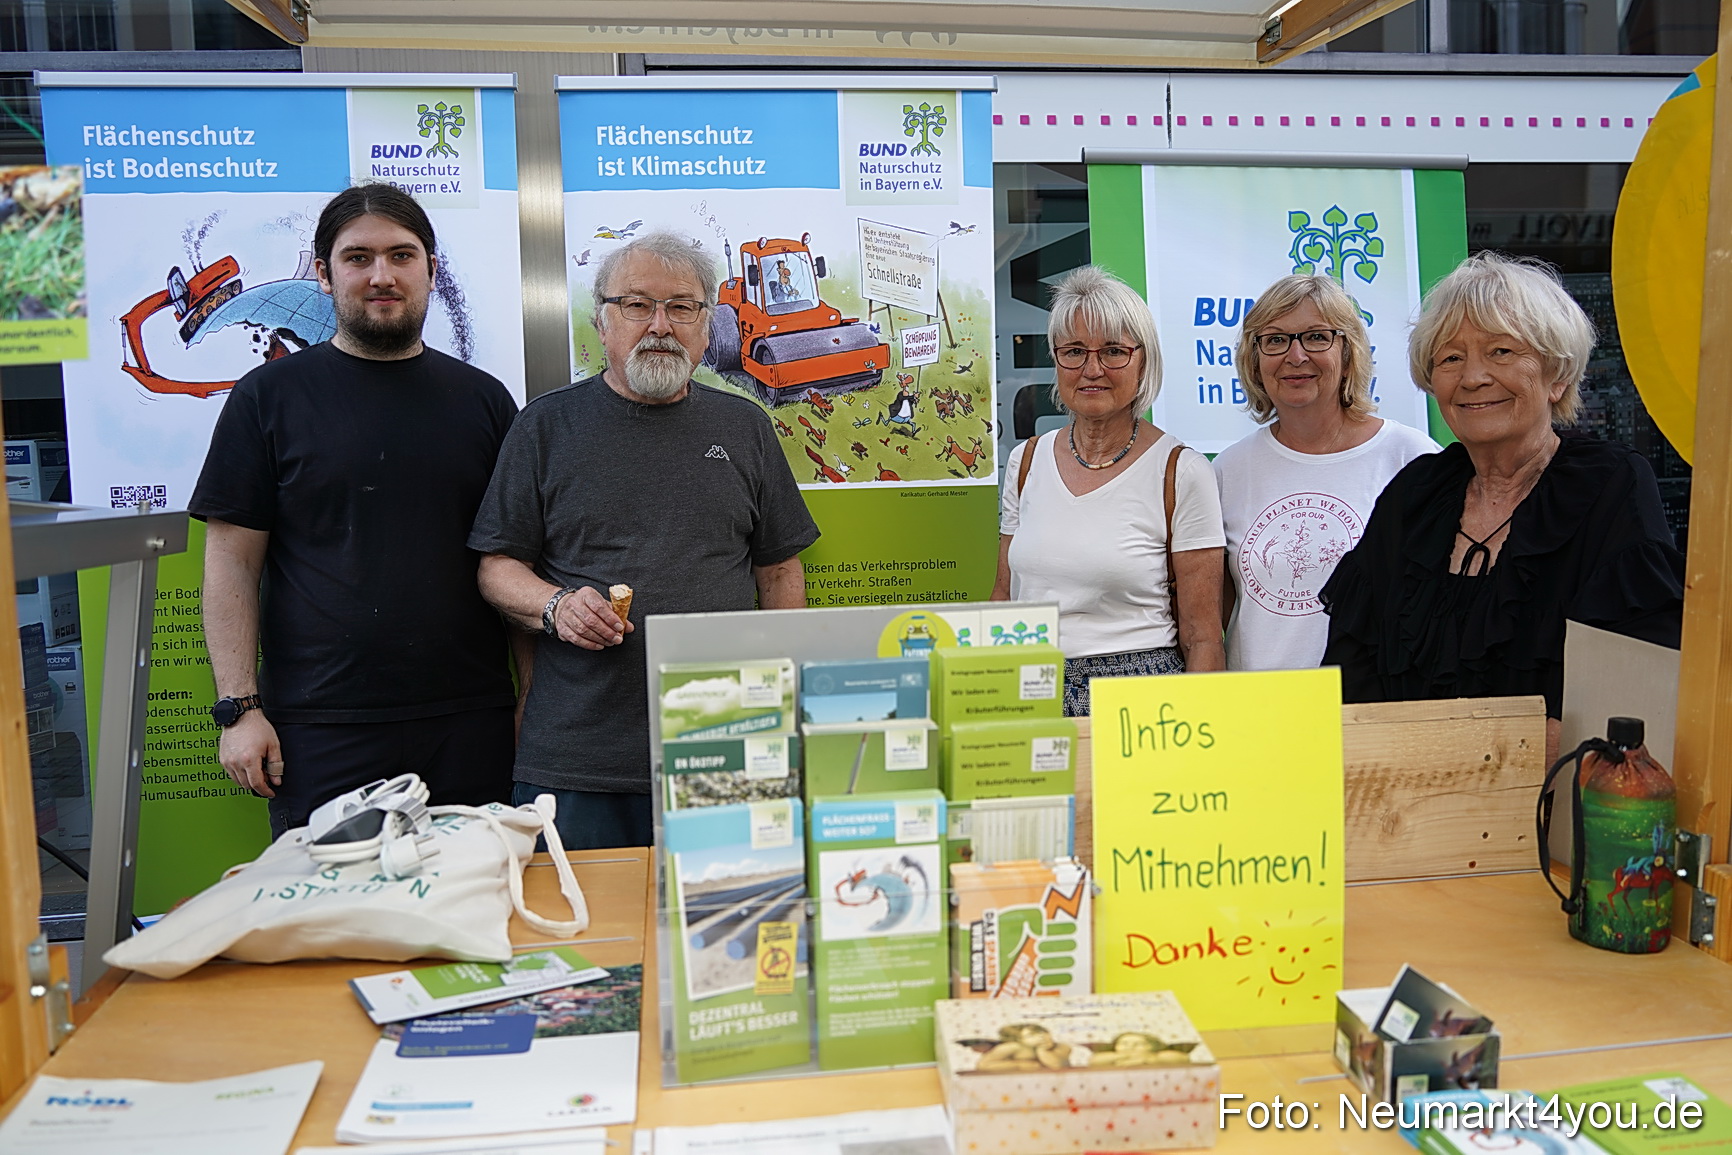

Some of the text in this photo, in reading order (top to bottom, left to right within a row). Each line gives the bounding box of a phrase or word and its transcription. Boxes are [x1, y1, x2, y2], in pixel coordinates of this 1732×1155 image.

[83, 124, 256, 147] Flächenschutz
[596, 124, 754, 147] Flächenschutz
[370, 144, 423, 158] BUND
[859, 143, 907, 157] BUND
[85, 156, 279, 179] ist Bodenschutz
[371, 163, 461, 177] Naturschutz
[597, 155, 767, 177] ist Klimaschutz
[859, 160, 942, 175] Naturschutz
[440, 181, 462, 194] e.V.
[860, 178, 943, 194] in Bayern e.V.
[866, 262, 922, 290] Schnellstraße
[1194, 297, 1256, 328] BU
[905, 329, 936, 345] SCHÖPFUNG
[1198, 376, 1222, 404] in
[1266, 498, 1313, 521] PLANET
[1320, 500, 1338, 512] WE
[1308, 512, 1325, 520] OUR
[1247, 522, 1266, 545] OUR
[804, 558, 957, 575] lösen das Verkehrsproblem
[1241, 549, 1267, 599] PROTECT
[818, 577, 865, 589] Verkehr.
[868, 576, 912, 588] Straßen
[176, 587, 203, 600] Bod
[828, 594, 845, 605] Sie
[848, 592, 903, 605] versiegeln
[906, 590, 968, 602] zusätzliche
[1278, 588, 1312, 598] FUTURE
[172, 604, 203, 616] Nied
[162, 638, 188, 650] sich
[173, 655, 192, 666] wir
[1119, 702, 1215, 758] Infos
[1151, 791, 1228, 815] zum
[1112, 830, 1327, 893] Mitnehmen!
[1122, 926, 1253, 969] Danke
[688, 1001, 765, 1026] DEZENTRAL
[747, 1010, 799, 1032] BESSER
